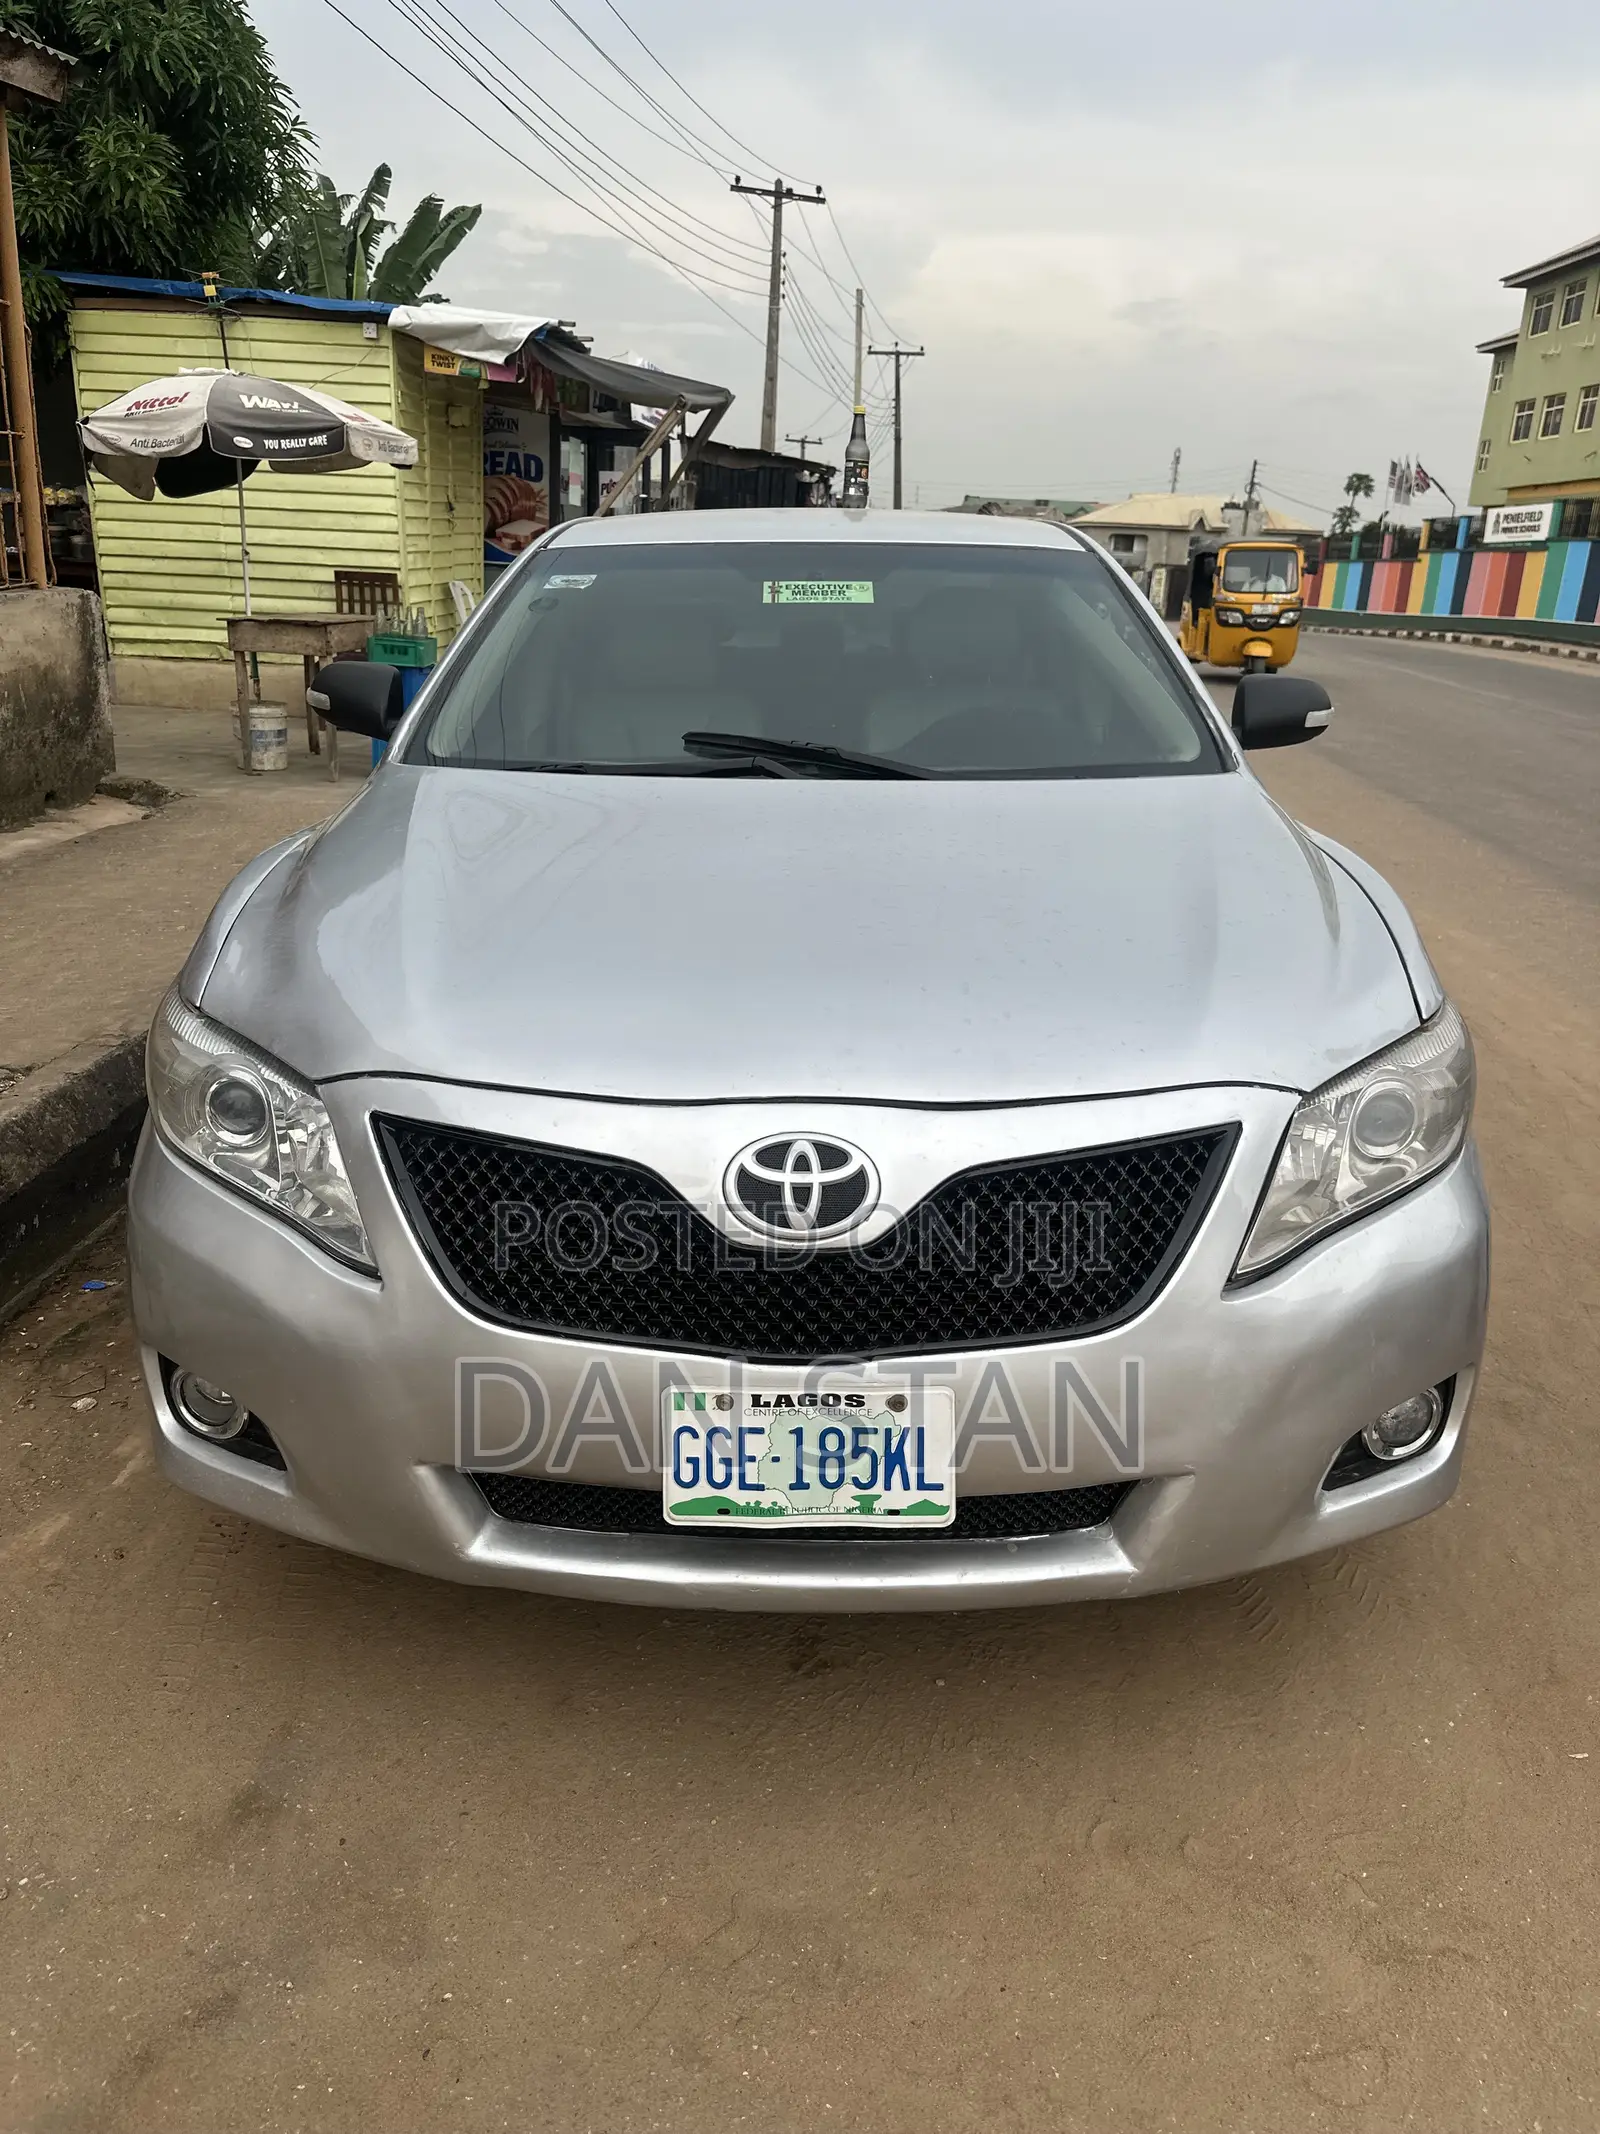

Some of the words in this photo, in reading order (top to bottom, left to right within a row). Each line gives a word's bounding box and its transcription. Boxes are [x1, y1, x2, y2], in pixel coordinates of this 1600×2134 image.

[431, 353, 455, 362] KINKY
[431, 360, 456, 369] TWIST
[126, 391, 190, 411] Nittol
[130, 438, 149, 449] Anti
[150, 433, 185, 448] Bacterial
[263, 439, 278, 450] YOU
[280, 438, 307, 450] REALLY
[308, 434, 328, 447] CARE
[750, 1393, 866, 1408] LAGOS
[743, 1407, 785, 1417] CENTRE
[787, 1407, 804, 1417] OF
[806, 1407, 873, 1417] EXCELLENCE
[672, 1425, 945, 1492] GGE-185KL
[735, 1506, 777, 1516] FEDERAL
[828, 1506, 840, 1514] OF
[843, 1506, 884, 1514] NIGERIA
